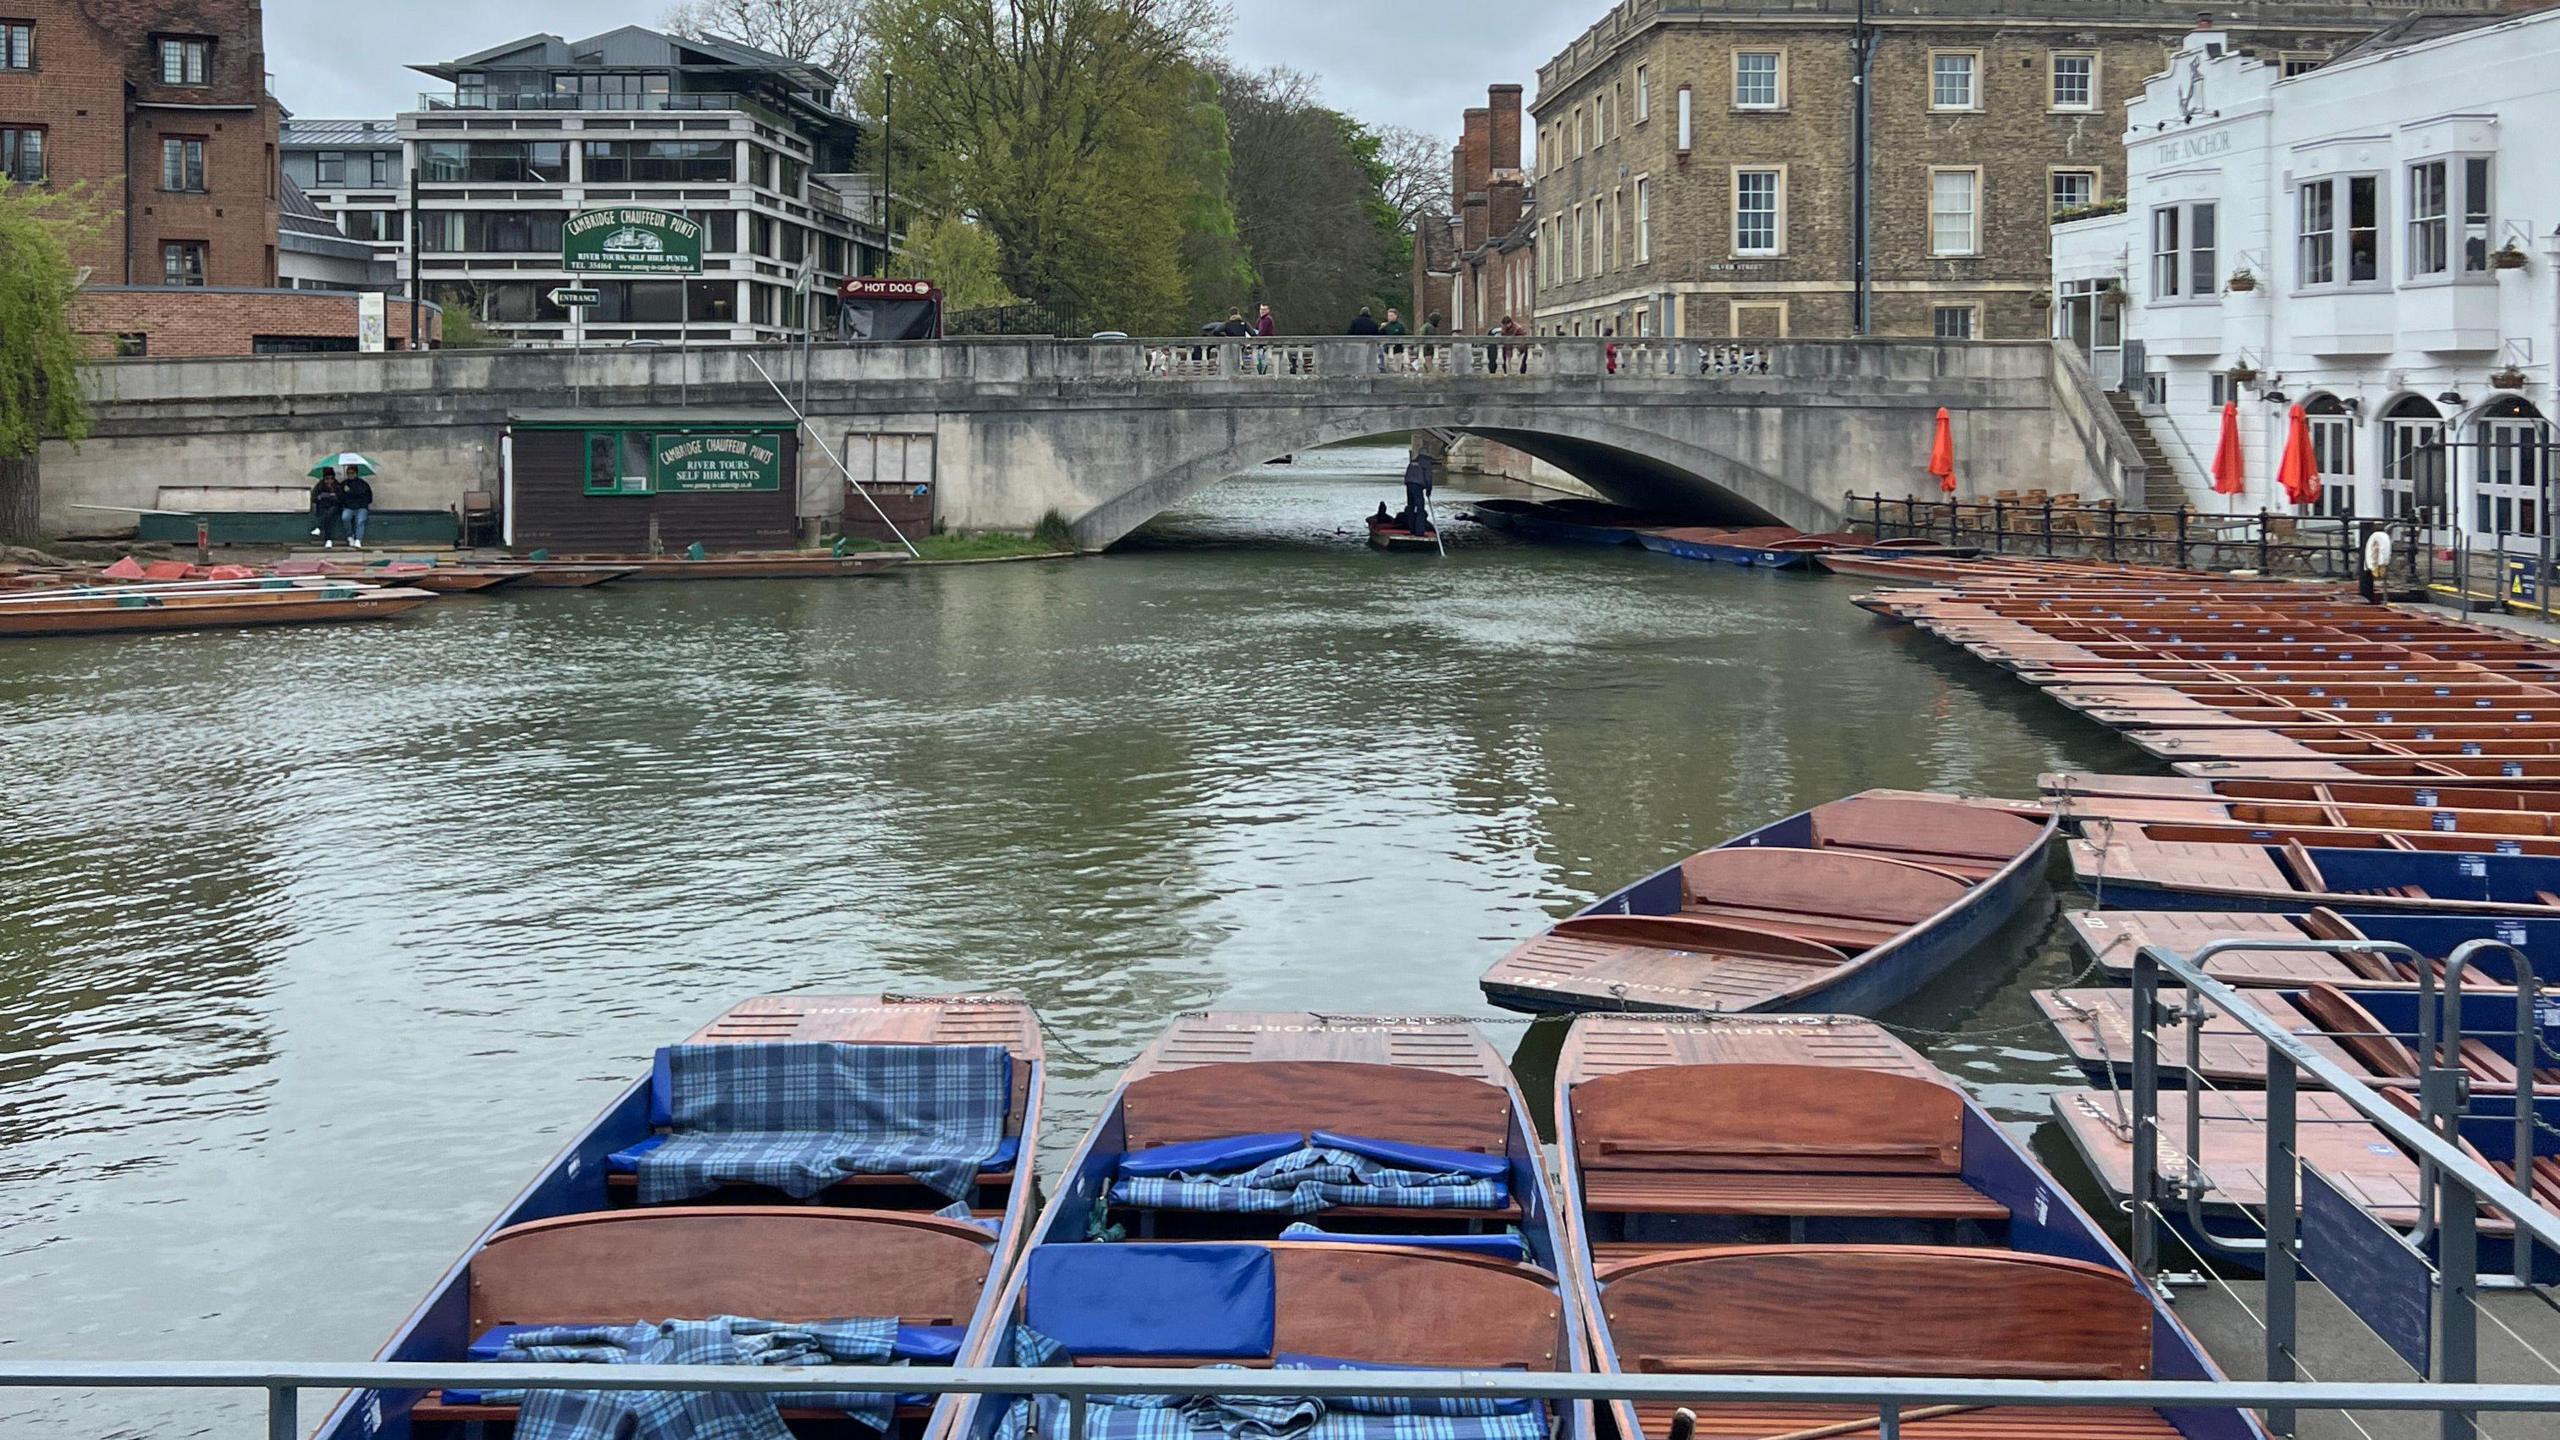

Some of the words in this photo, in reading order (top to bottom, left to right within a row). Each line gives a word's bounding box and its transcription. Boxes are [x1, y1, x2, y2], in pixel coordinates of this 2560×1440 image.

[2158, 142, 2179, 164] THE
[2183, 130, 2232, 159] ANCHOR
[567, 210, 615, 236] CAMBRIDGE
[620, 209, 666, 227] CHAUFFEUR
[669, 217, 698, 239] PUNTS
[577, 253, 600, 261] RIVER
[628, 253, 645, 262] SELF
[647, 254, 665, 262] HIRE
[666, 254, 689, 263] PUNTS
[864, 283, 886, 292] HOT
[889, 283, 913, 292] DOG
[558, 293, 597, 302] ENTRANCE
[660, 440, 703, 466] CAMBRIDGE
[706, 438, 747, 455] CHAUFFEUR
[749, 445, 774, 465] PUNTS
[687, 460, 716, 470] RIVER
[719, 460, 750, 469] TOURS
[676, 470, 699, 480] SELF
[702, 470, 727, 480] HIRE
[729, 470, 760, 480] PUNTS
[1225, 1023, 1424, 1034] SCUDAMORE'S
